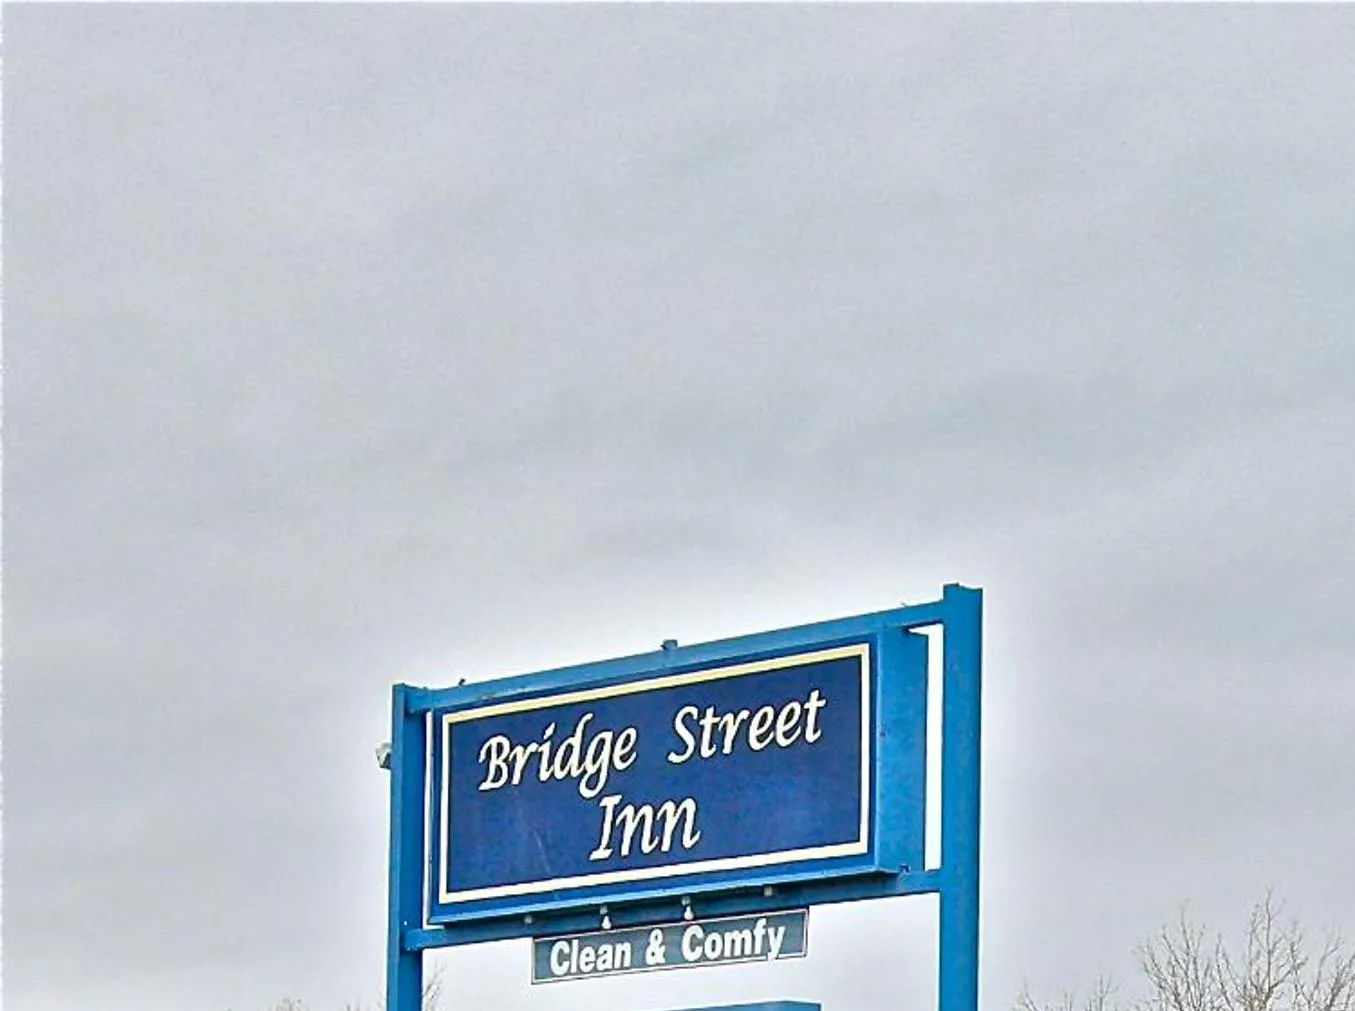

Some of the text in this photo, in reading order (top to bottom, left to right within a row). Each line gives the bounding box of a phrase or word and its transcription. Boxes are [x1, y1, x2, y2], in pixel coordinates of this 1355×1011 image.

[478, 688, 826, 798] Bridge Street
[589, 796, 701, 861] Inn
[550, 917, 786, 976] Clean & Comfy
